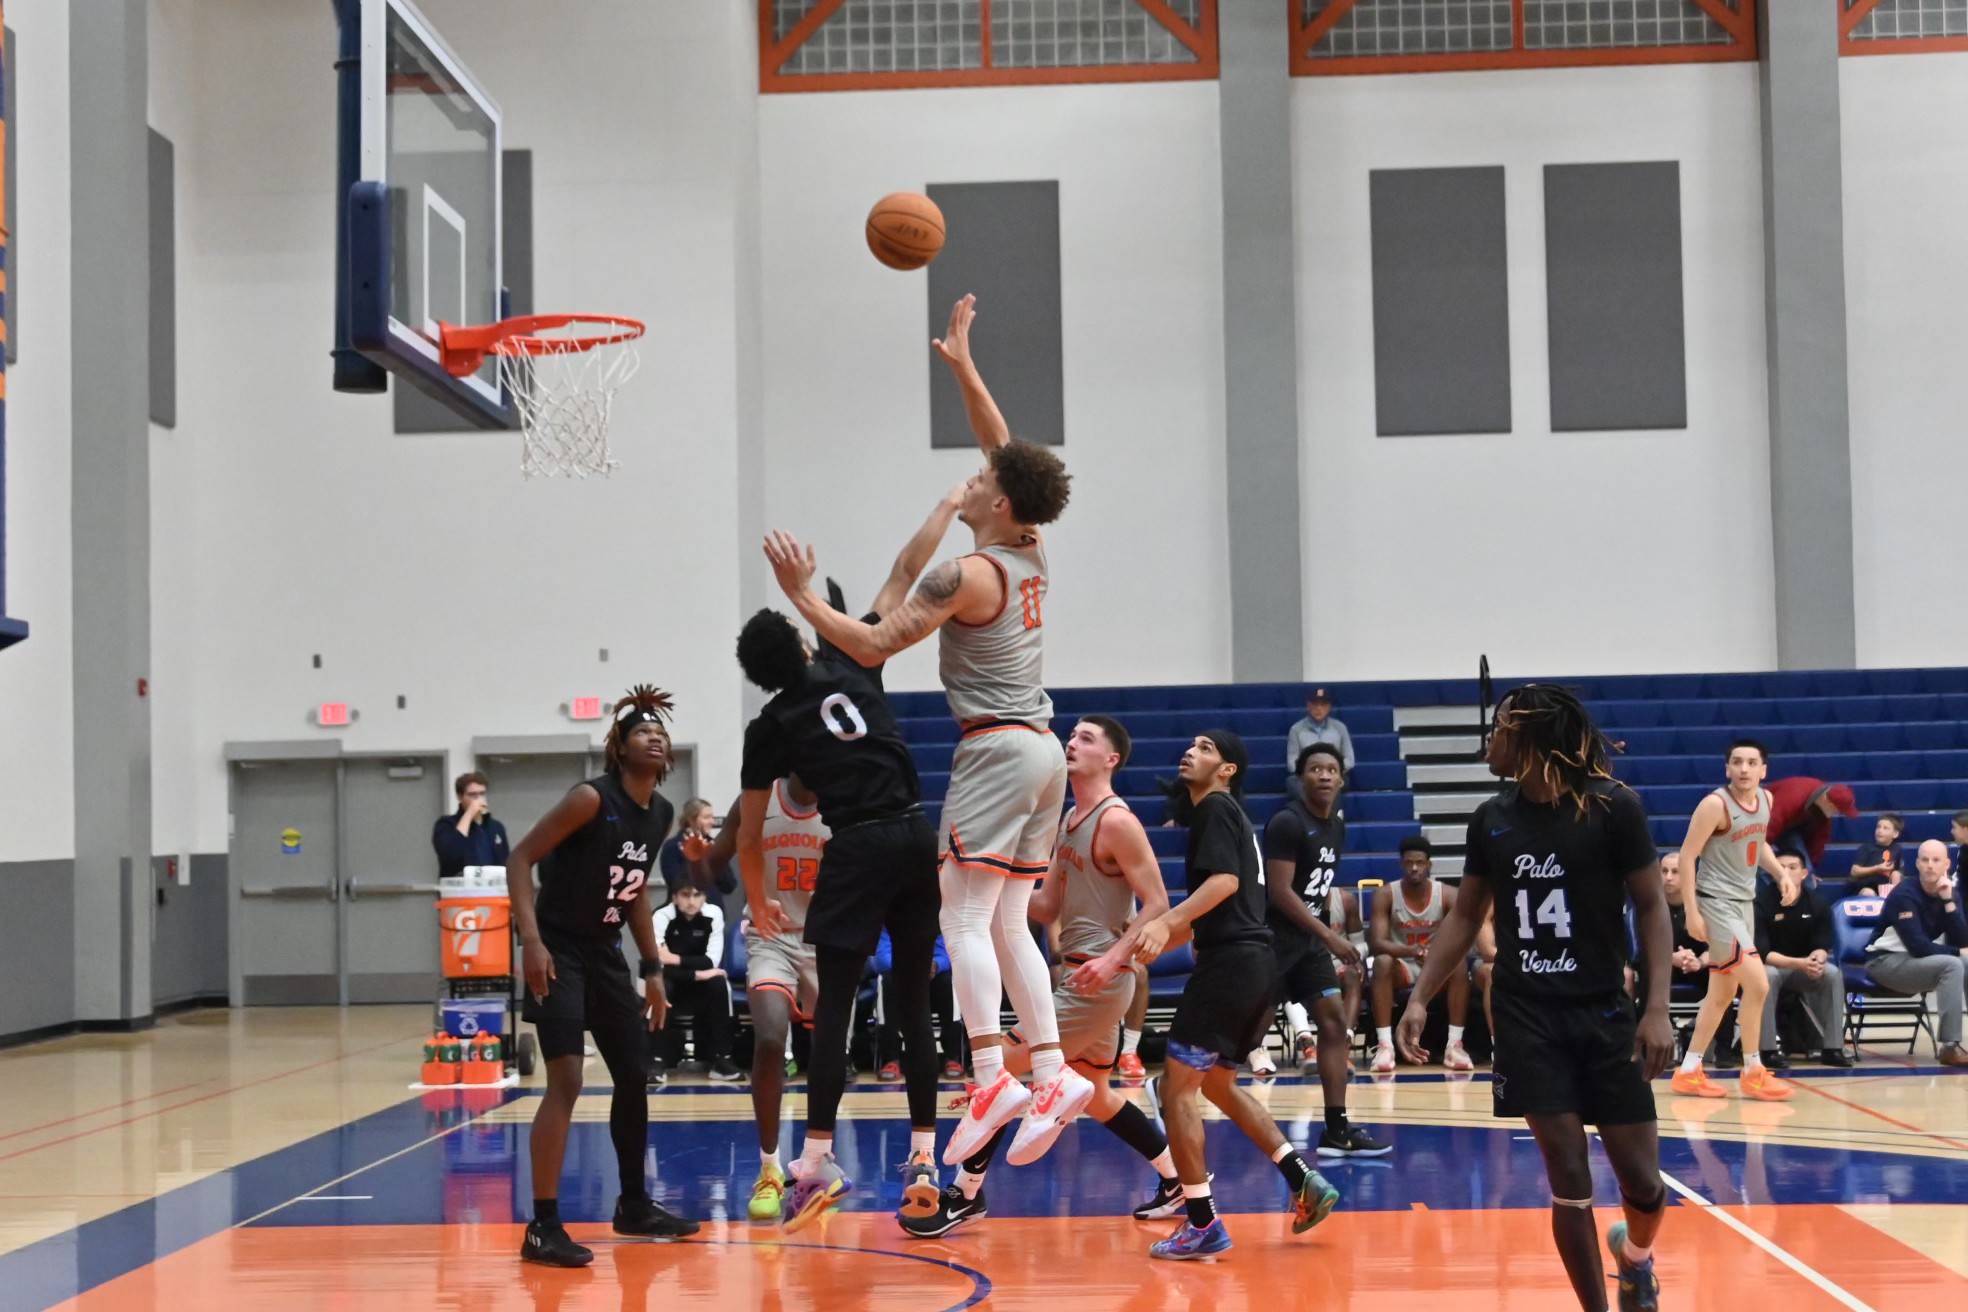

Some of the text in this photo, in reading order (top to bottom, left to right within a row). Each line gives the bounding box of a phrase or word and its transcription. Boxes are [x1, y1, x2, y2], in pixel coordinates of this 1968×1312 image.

[1019, 575, 1042, 630] 11
[820, 692, 868, 741] 0
[776, 855, 818, 892] 22
[1303, 867, 1335, 897] 23
[1512, 852, 1565, 879] Palo
[1515, 888, 1572, 939] 14
[1519, 947, 1578, 973] Verde
